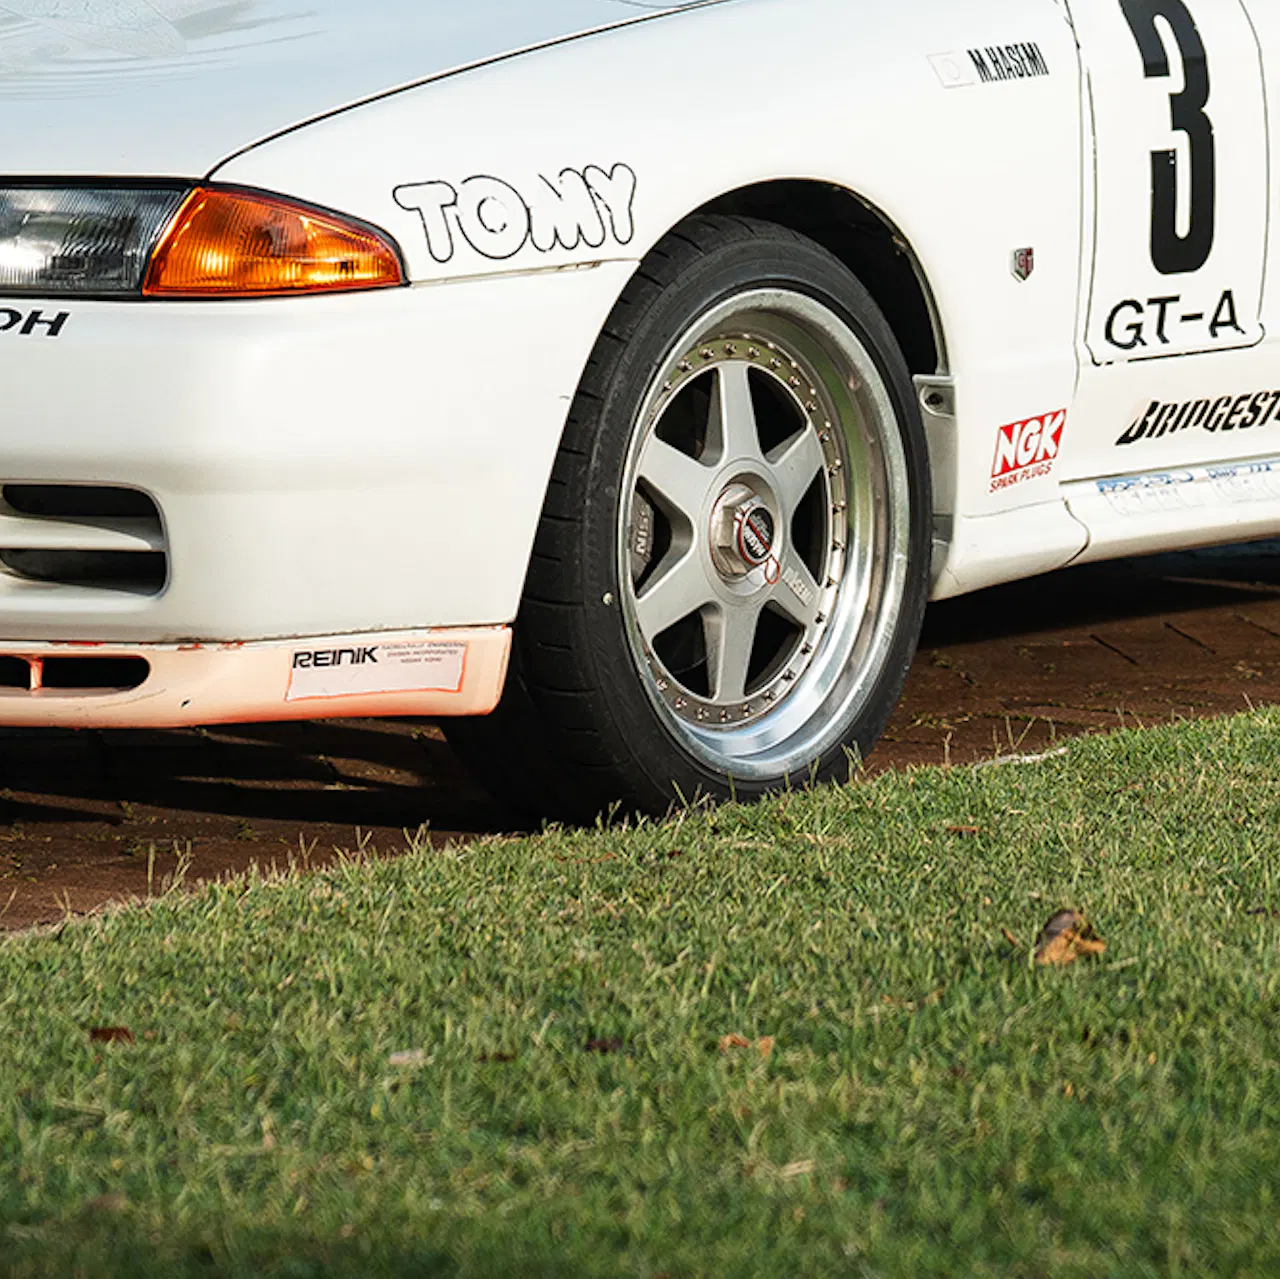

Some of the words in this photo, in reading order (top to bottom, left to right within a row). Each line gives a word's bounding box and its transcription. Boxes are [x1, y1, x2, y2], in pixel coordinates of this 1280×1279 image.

[391, 162, 637, 263] TOMY
[1104, 289, 1248, 351] GT-A
[993, 409, 1065, 477] NGK
[292, 646, 379, 669] REINIK
